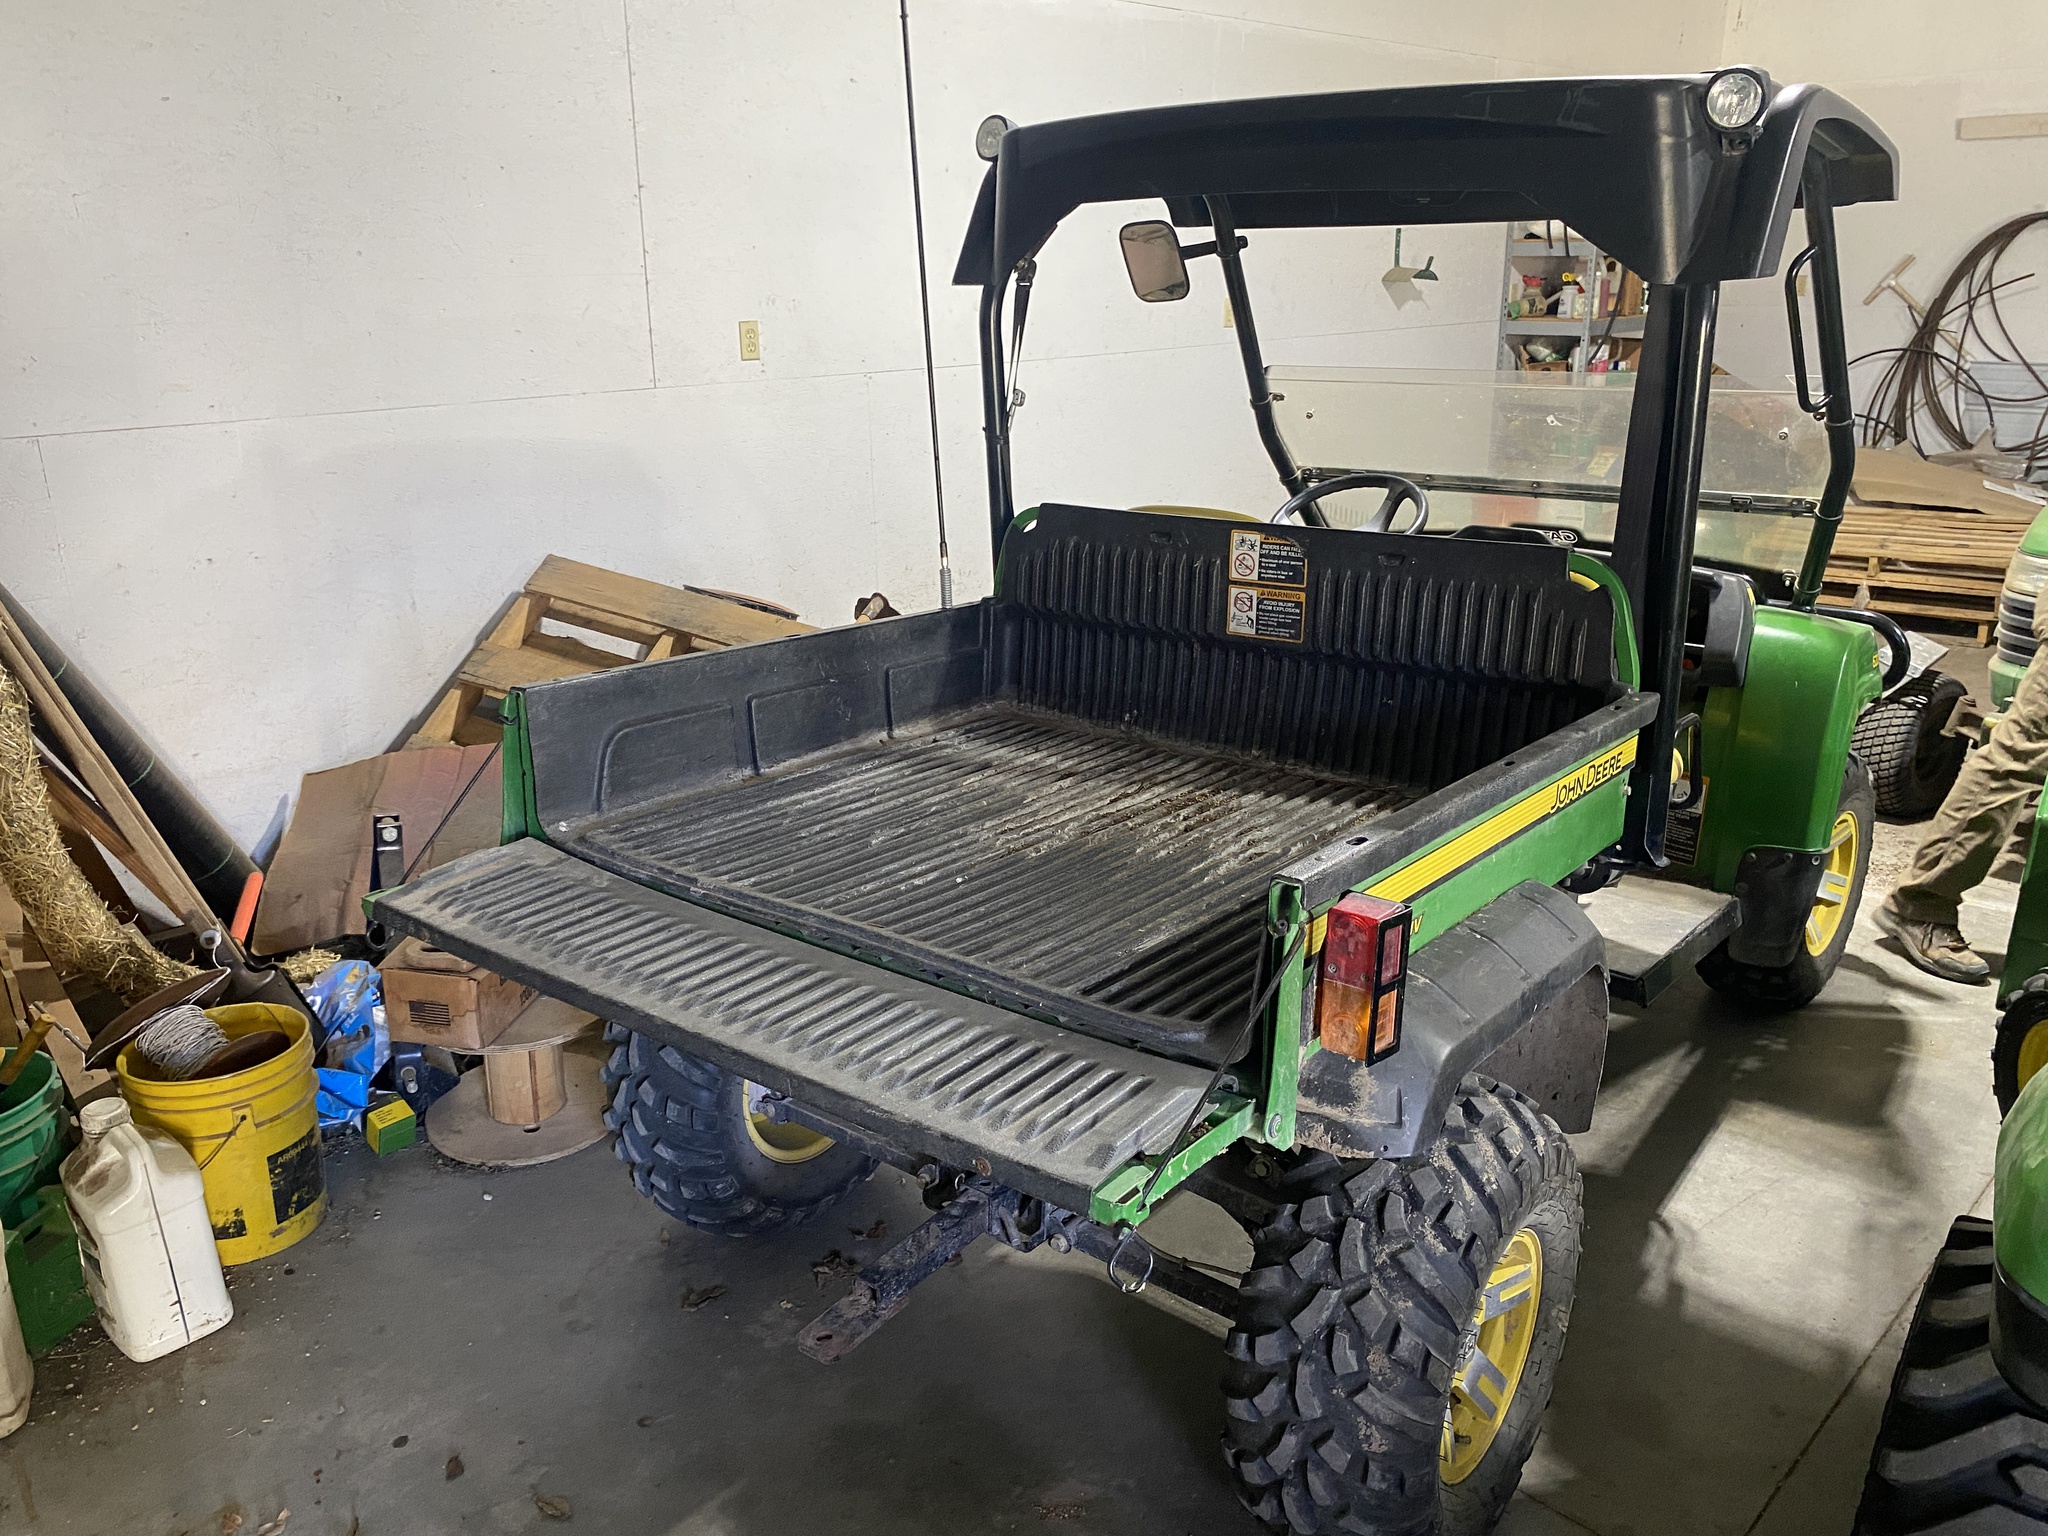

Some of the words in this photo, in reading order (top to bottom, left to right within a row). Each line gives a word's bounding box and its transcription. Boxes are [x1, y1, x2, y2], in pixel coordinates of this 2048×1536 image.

[1266, 590, 1300, 600] WARNING
[1550, 774, 1585, 811] JOHN
[1586, 751, 1623, 789] DEERE
